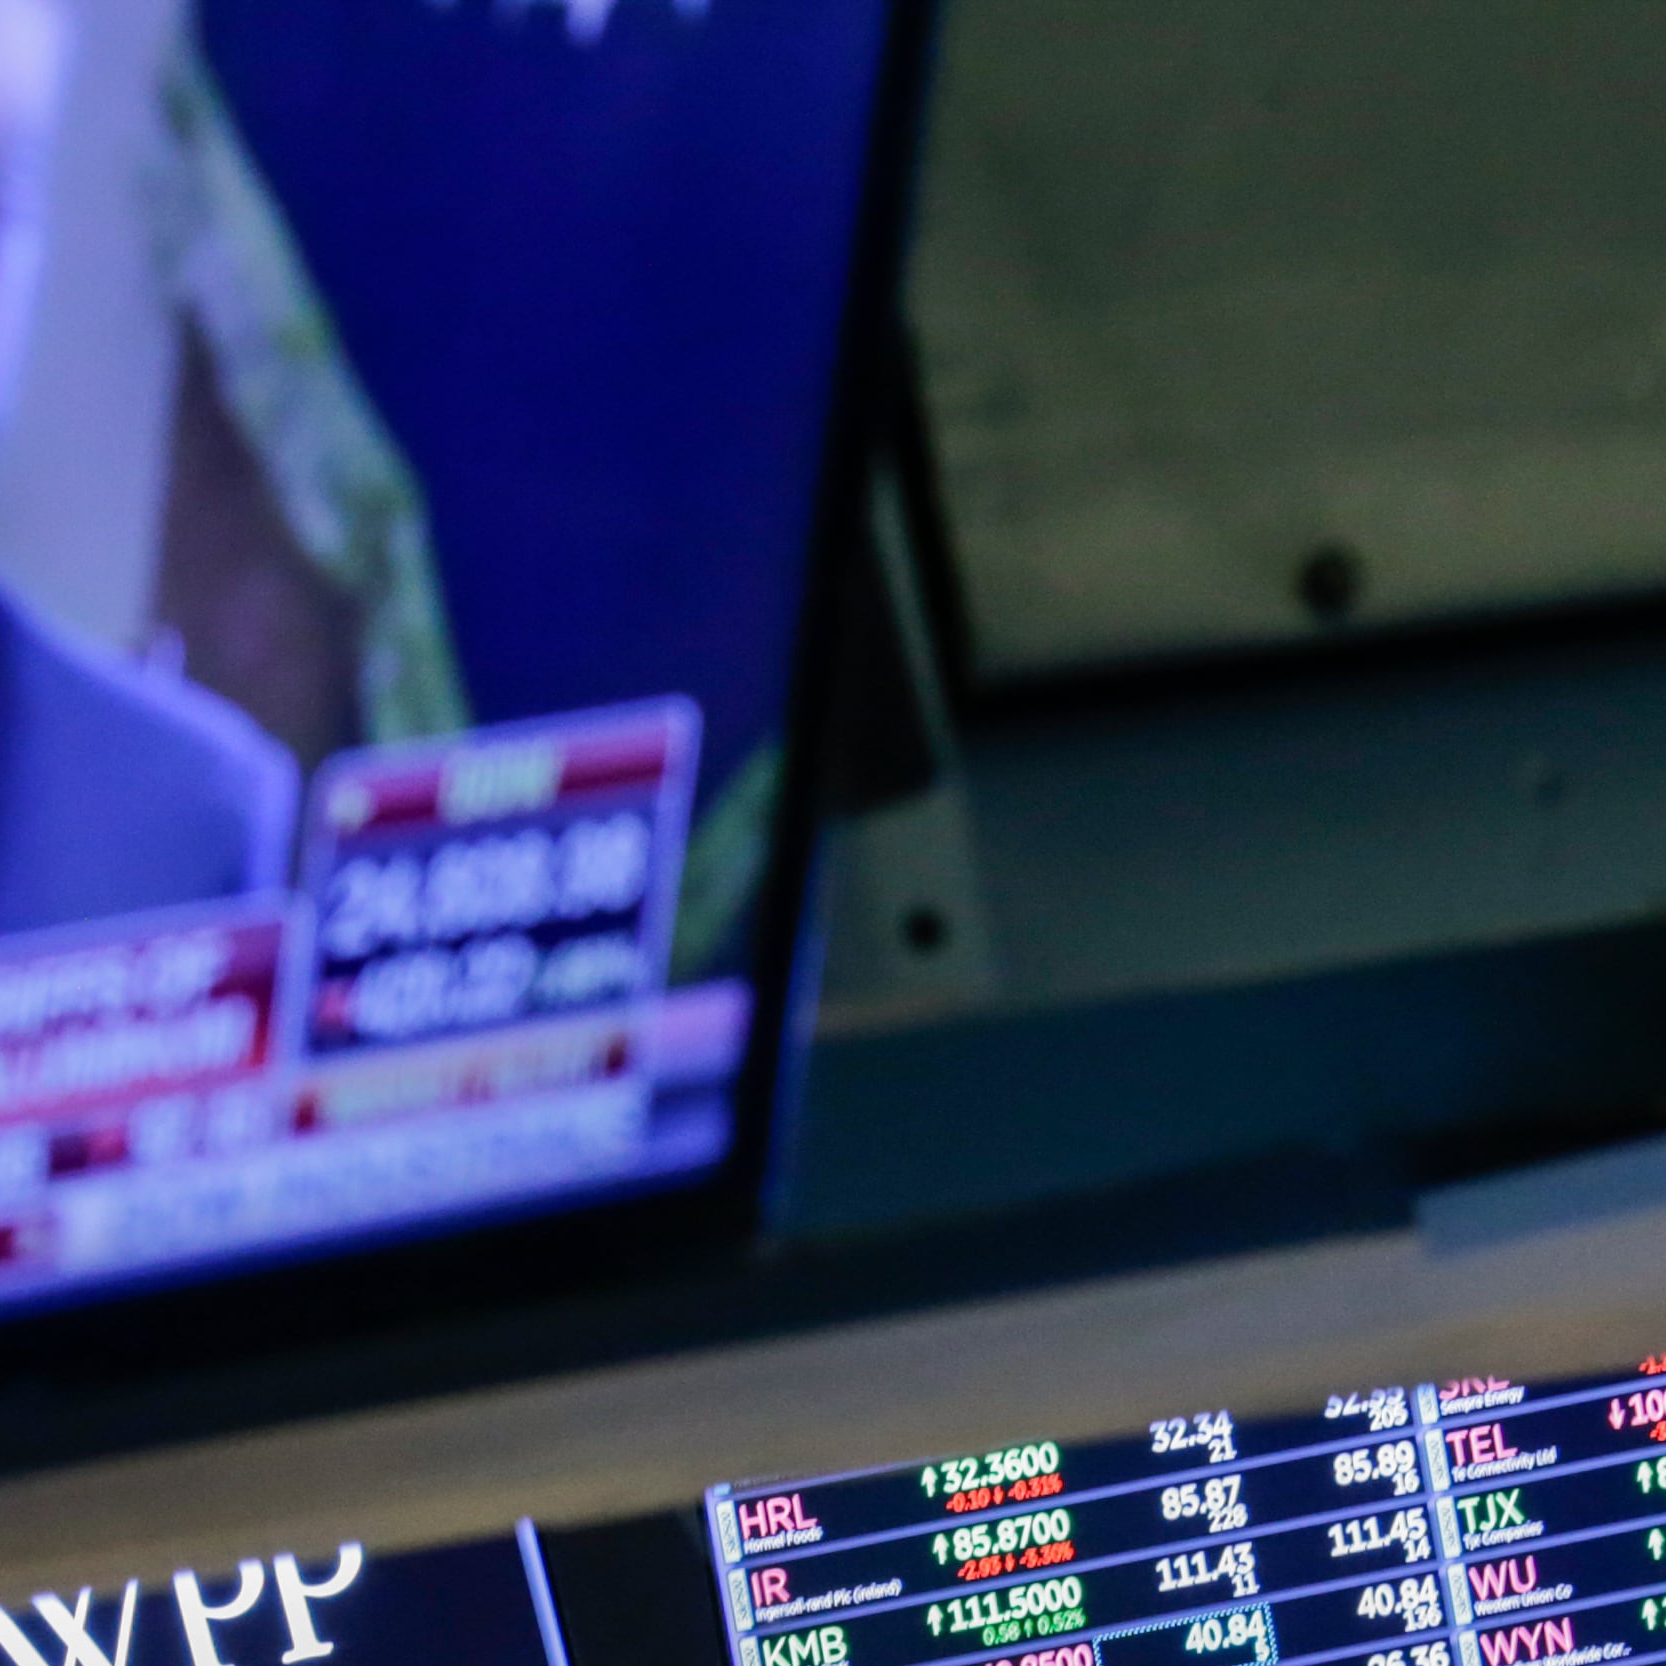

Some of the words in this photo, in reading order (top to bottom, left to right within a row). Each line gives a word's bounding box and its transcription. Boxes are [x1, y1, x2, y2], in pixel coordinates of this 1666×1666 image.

[1150, 1409, 1233, 1454] 32.34
[1446, 1423, 1518, 1467] TEL
[940, 1441, 1059, 1494] 32.3600
[1333, 1440, 1416, 1487] 85.89
[1393, 1468, 1420, 1496] 16
[738, 1493, 818, 1540] HRL
[1161, 1474, 1241, 1521] 85.87
[1457, 1488, 1525, 1535] TJX
[786, 1526, 823, 1546] Foods
[952, 1508, 1070, 1561] 85.8700
[1328, 1507, 1428, 1558] 111.45
[1404, 1535, 1432, 1564] 14
[750, 1567, 790, 1608] IR
[1155, 1542, 1256, 1593] 111.43
[1232, 1572, 1260, 1599] 11
[1469, 1555, 1537, 1600] WU
[947, 1575, 1082, 1633] 111.5000
[1357, 1574, 1439, 1619] 40.84
[1185, 1610, 1267, 1654] 40.84
